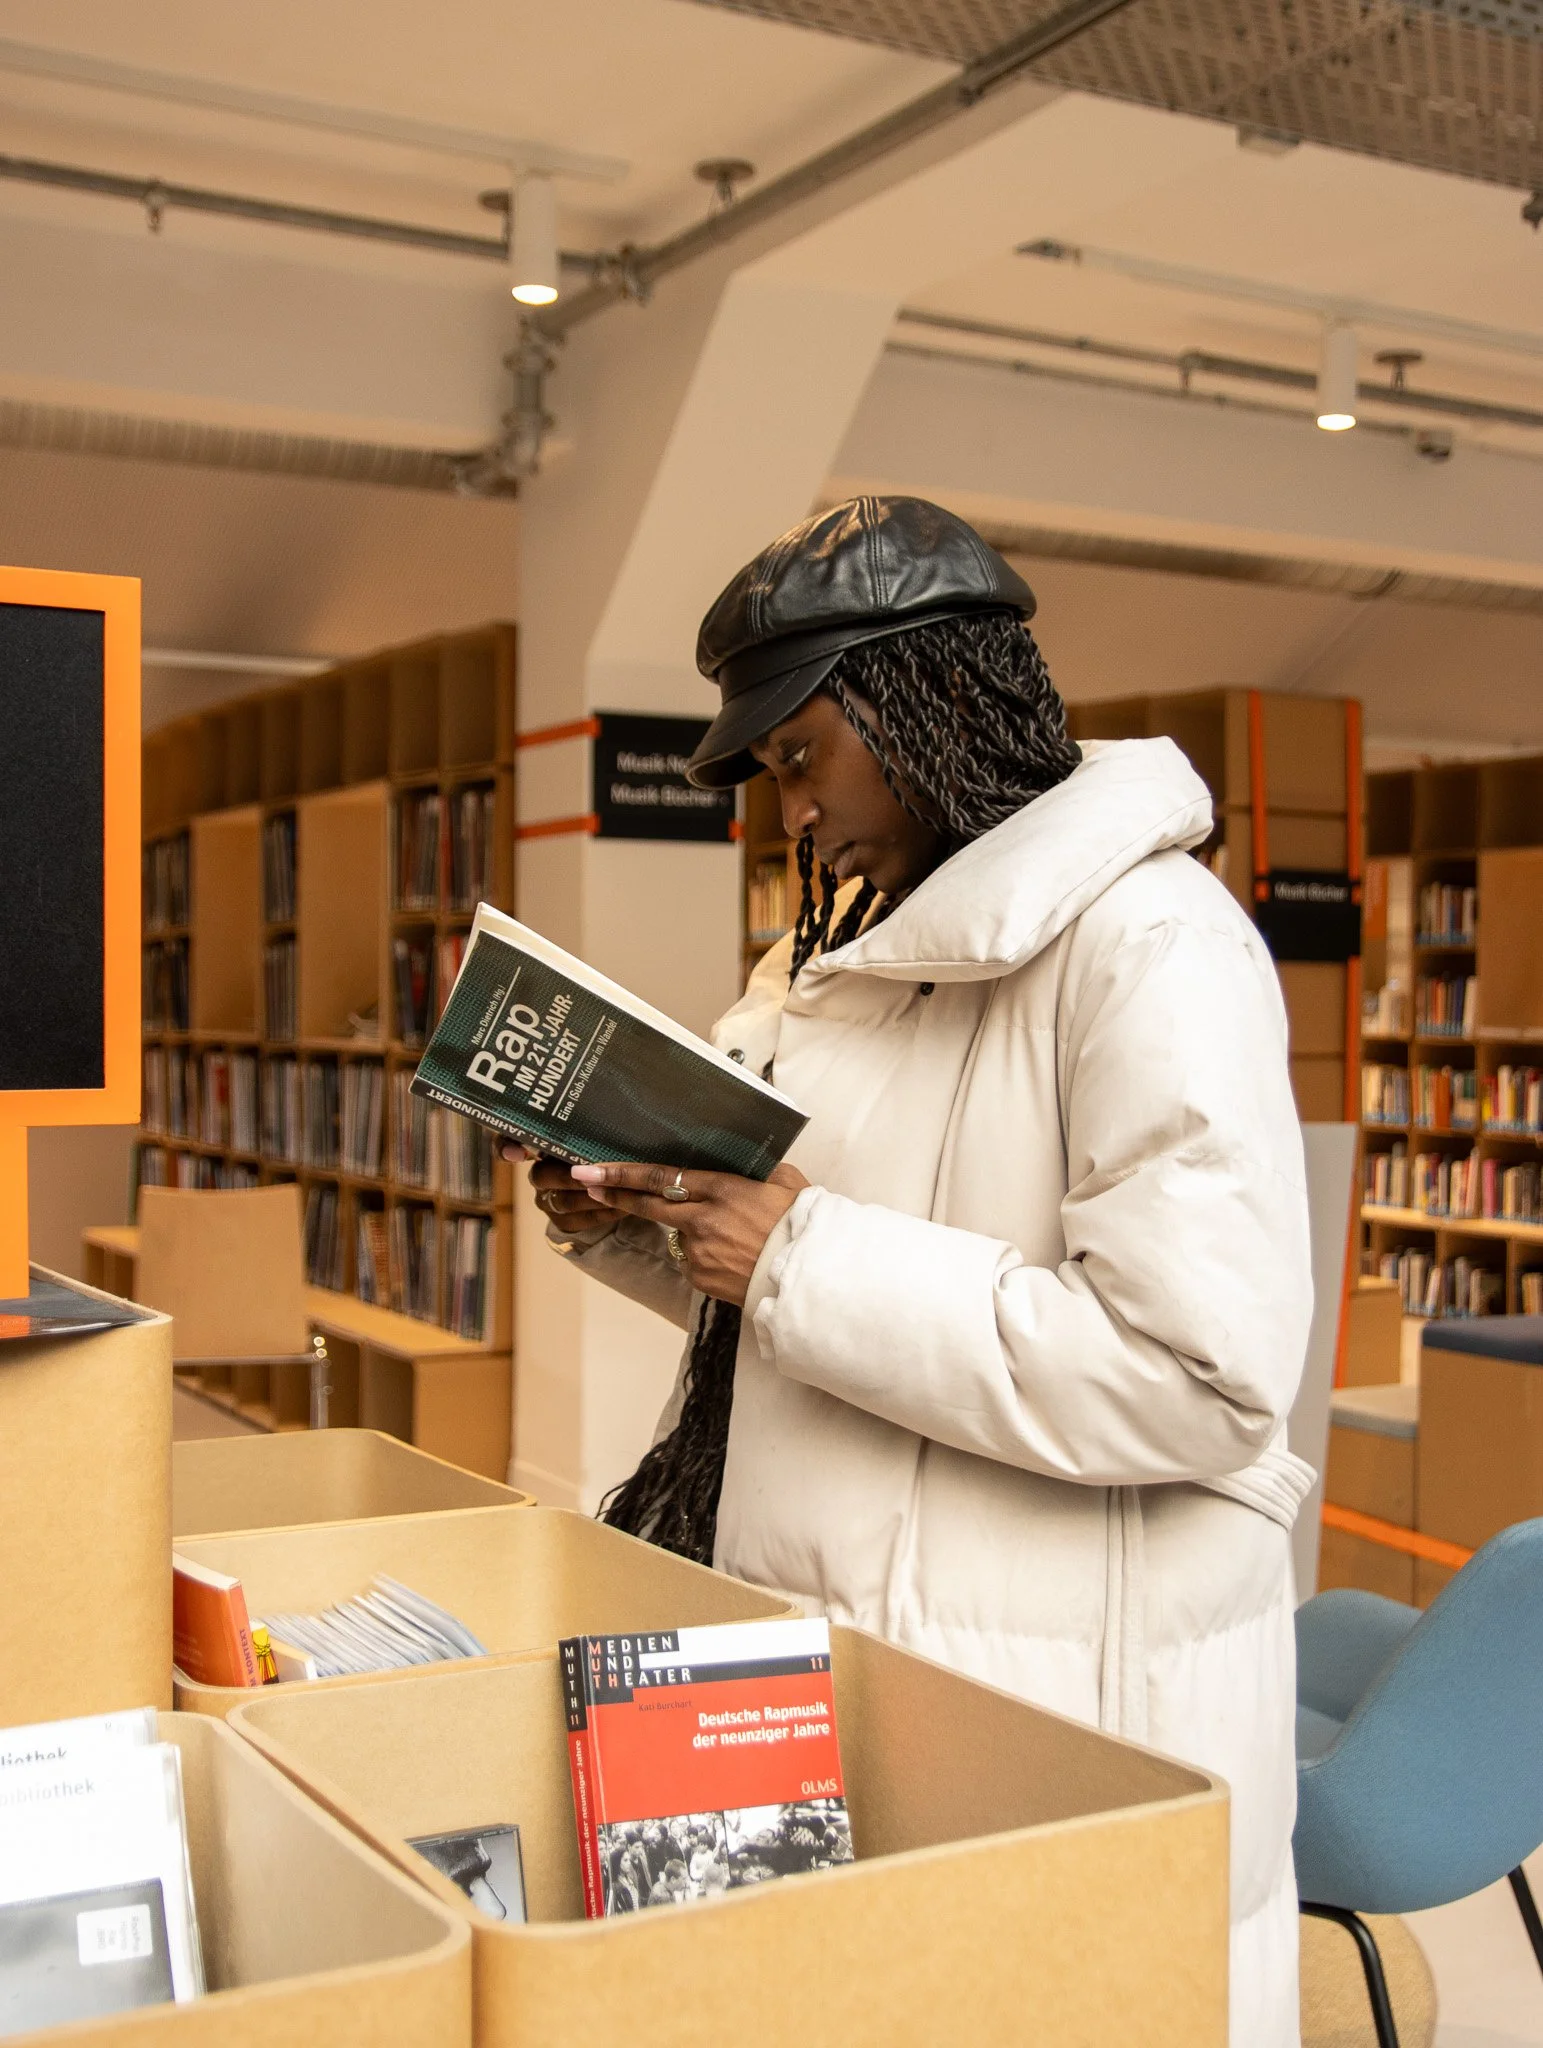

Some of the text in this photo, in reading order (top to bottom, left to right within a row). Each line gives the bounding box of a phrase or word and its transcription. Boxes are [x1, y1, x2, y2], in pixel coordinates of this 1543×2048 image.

[471, 1027, 486, 1045] Marc
[480, 999, 499, 1027] Dietrich
[466, 1004, 544, 1093] Rap
[512, 994, 573, 1092] IM 21. JAHR-
[527, 1028, 581, 1112] HUNDERT
[557, 1100, 575, 1122] Eine
[597, 1018, 618, 1046] Wandel
[426, 1088, 526, 1137] JAHRHUNDERT
[529, 1133, 549, 1148] 21.
[549, 1145, 568, 1158] IM
[240, 1629, 254, 1674] KONTEXT
[588, 1635, 672, 1655] MEDIEN
[591, 1655, 633, 1672] UND
[810, 1656, 823, 1671] 11
[592, 1667, 691, 1689] THEATER
[657, 1700, 693, 1710] Burchart
[698, 1701, 828, 1728] Deutsche Rapmusik
[692, 1723, 830, 1748] der neunziger Jahre
[575, 1739, 583, 1767] Jahre
[577, 1769, 588, 1819] neunziger
[801, 1778, 838, 1795] OLMS
[584, 1841, 594, 1888] Rapmusik
[589, 1890, 597, 1919] tsche
